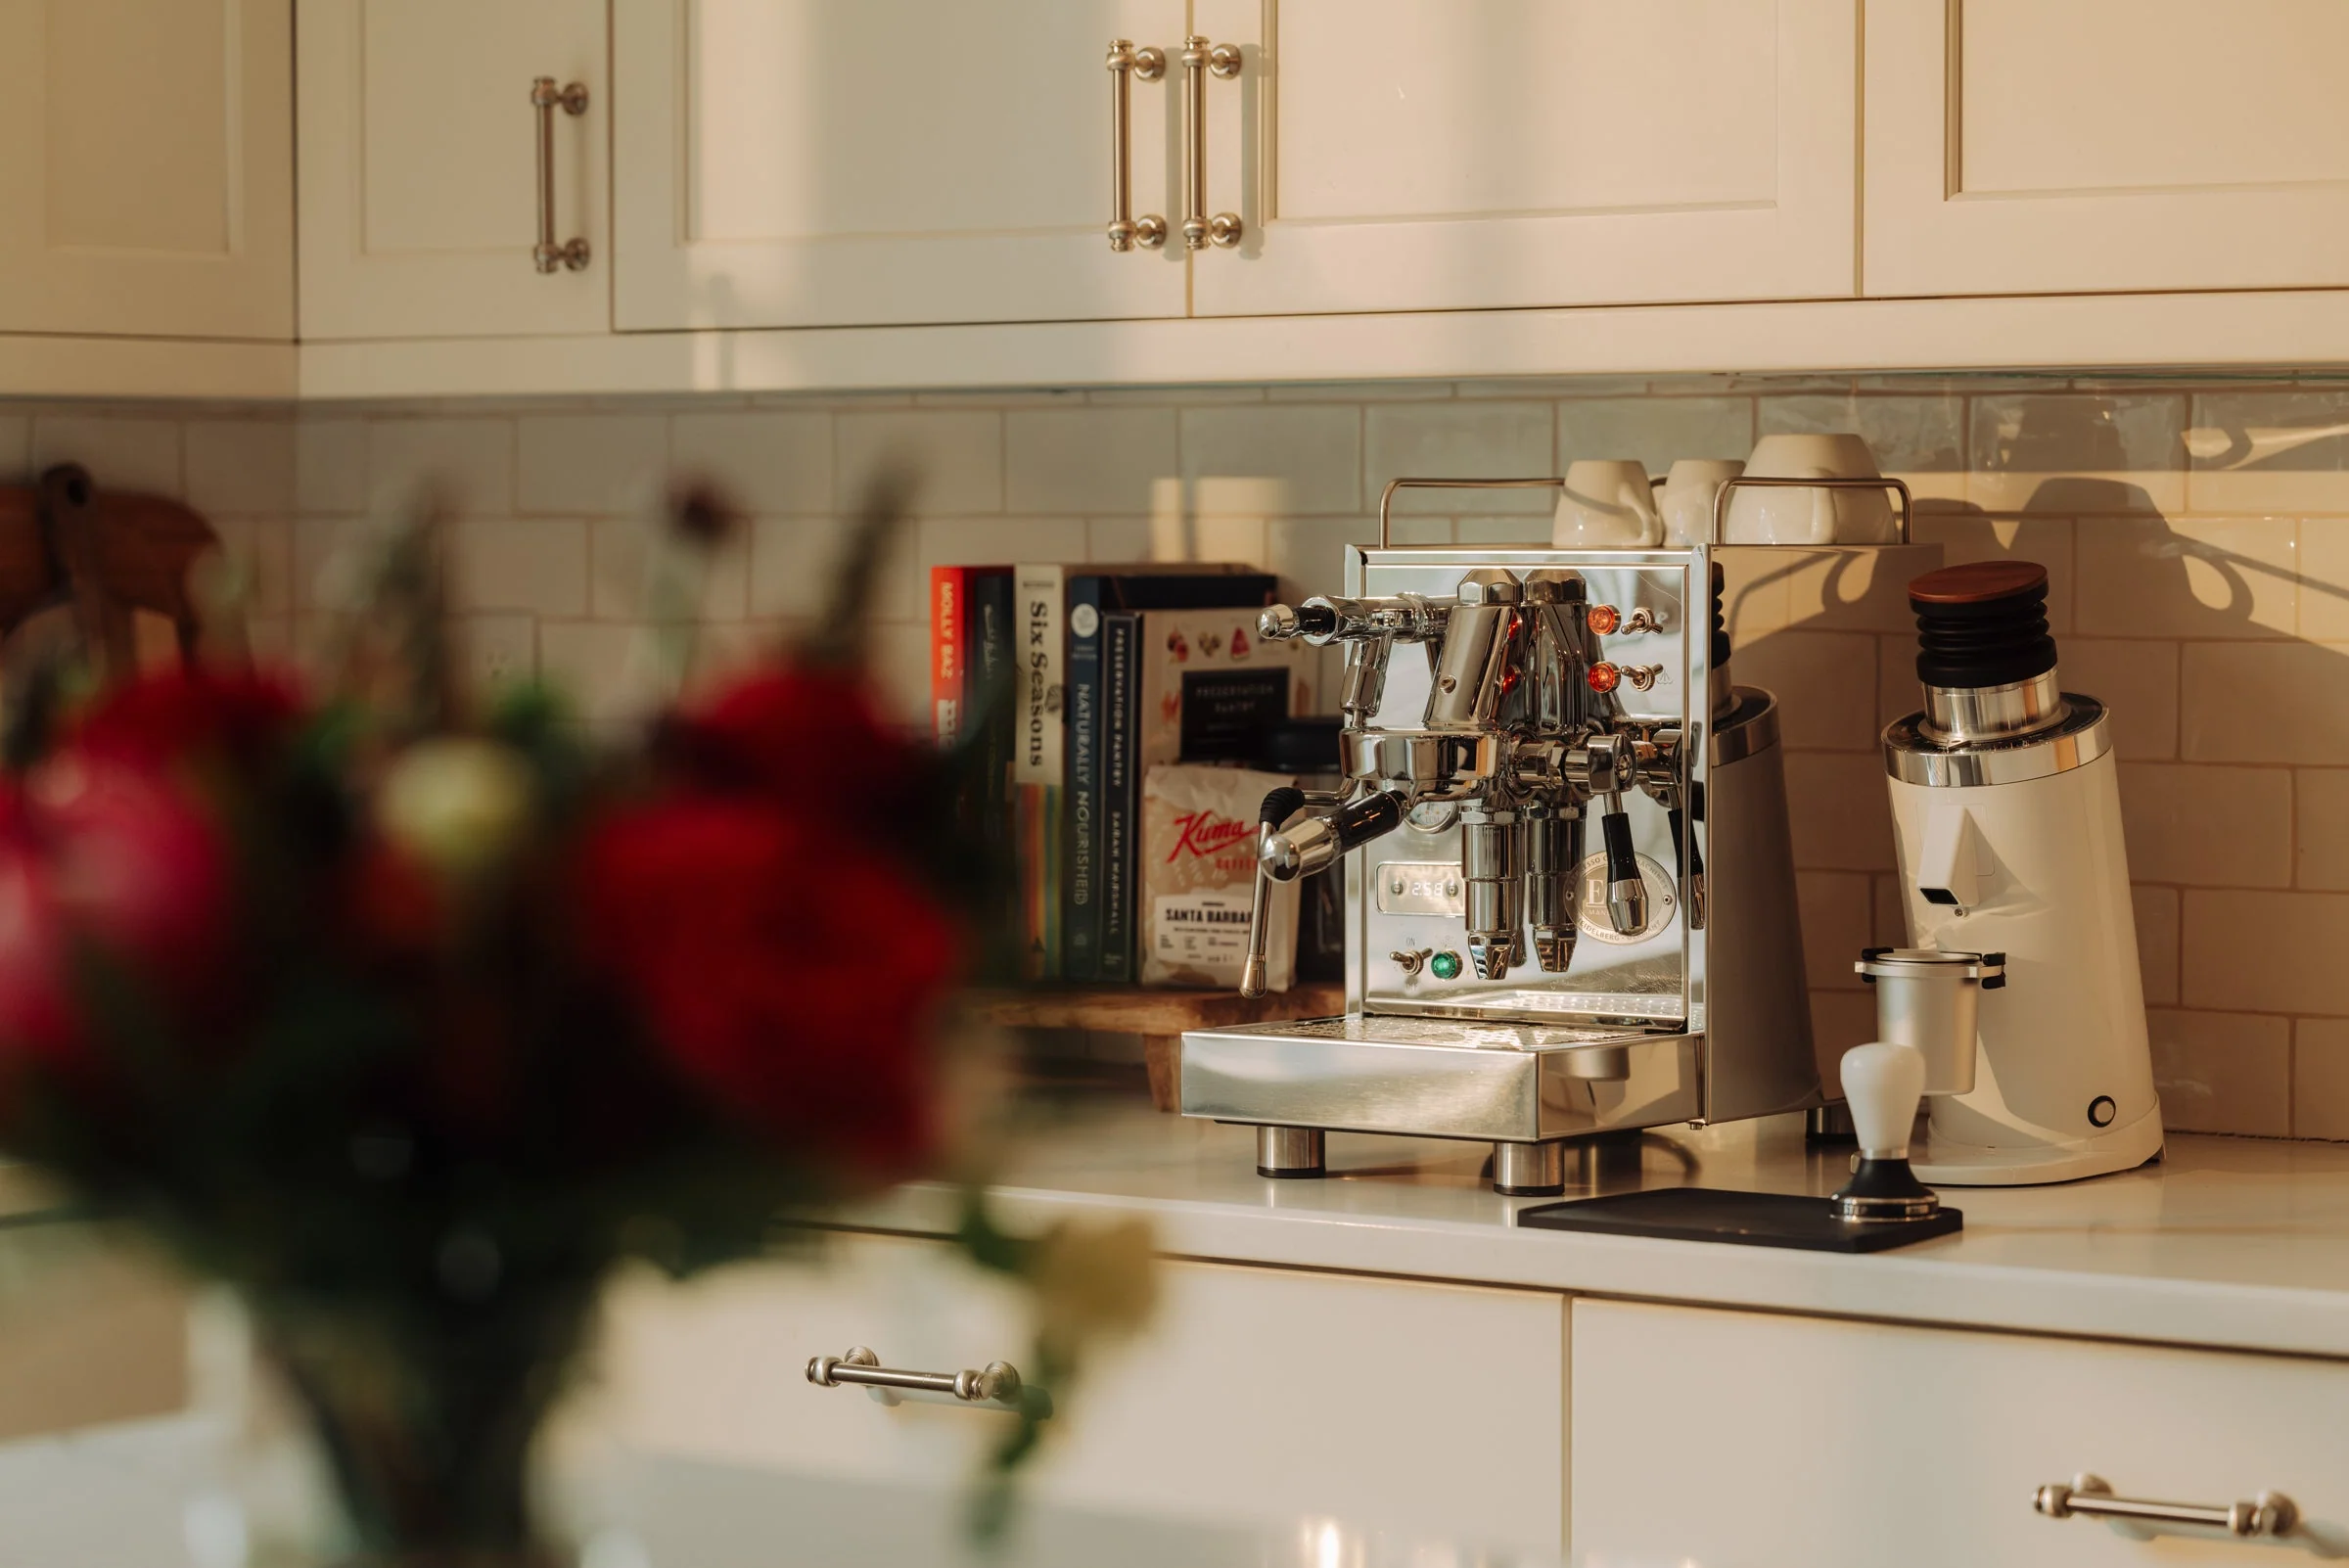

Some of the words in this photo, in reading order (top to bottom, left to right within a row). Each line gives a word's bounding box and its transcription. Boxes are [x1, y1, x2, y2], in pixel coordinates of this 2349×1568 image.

[941, 582, 953, 640] MOLLY
[1030, 601, 1047, 646] Six
[1030, 652, 1047, 767] Seasons
[1077, 684, 1091, 784] NATURALLY
[1075, 791, 1089, 905] NOURISHED
[1167, 809, 1260, 863] Kuma
[1166, 908, 1203, 921] SANTA
[1207, 910, 1252, 923] BARBAR
